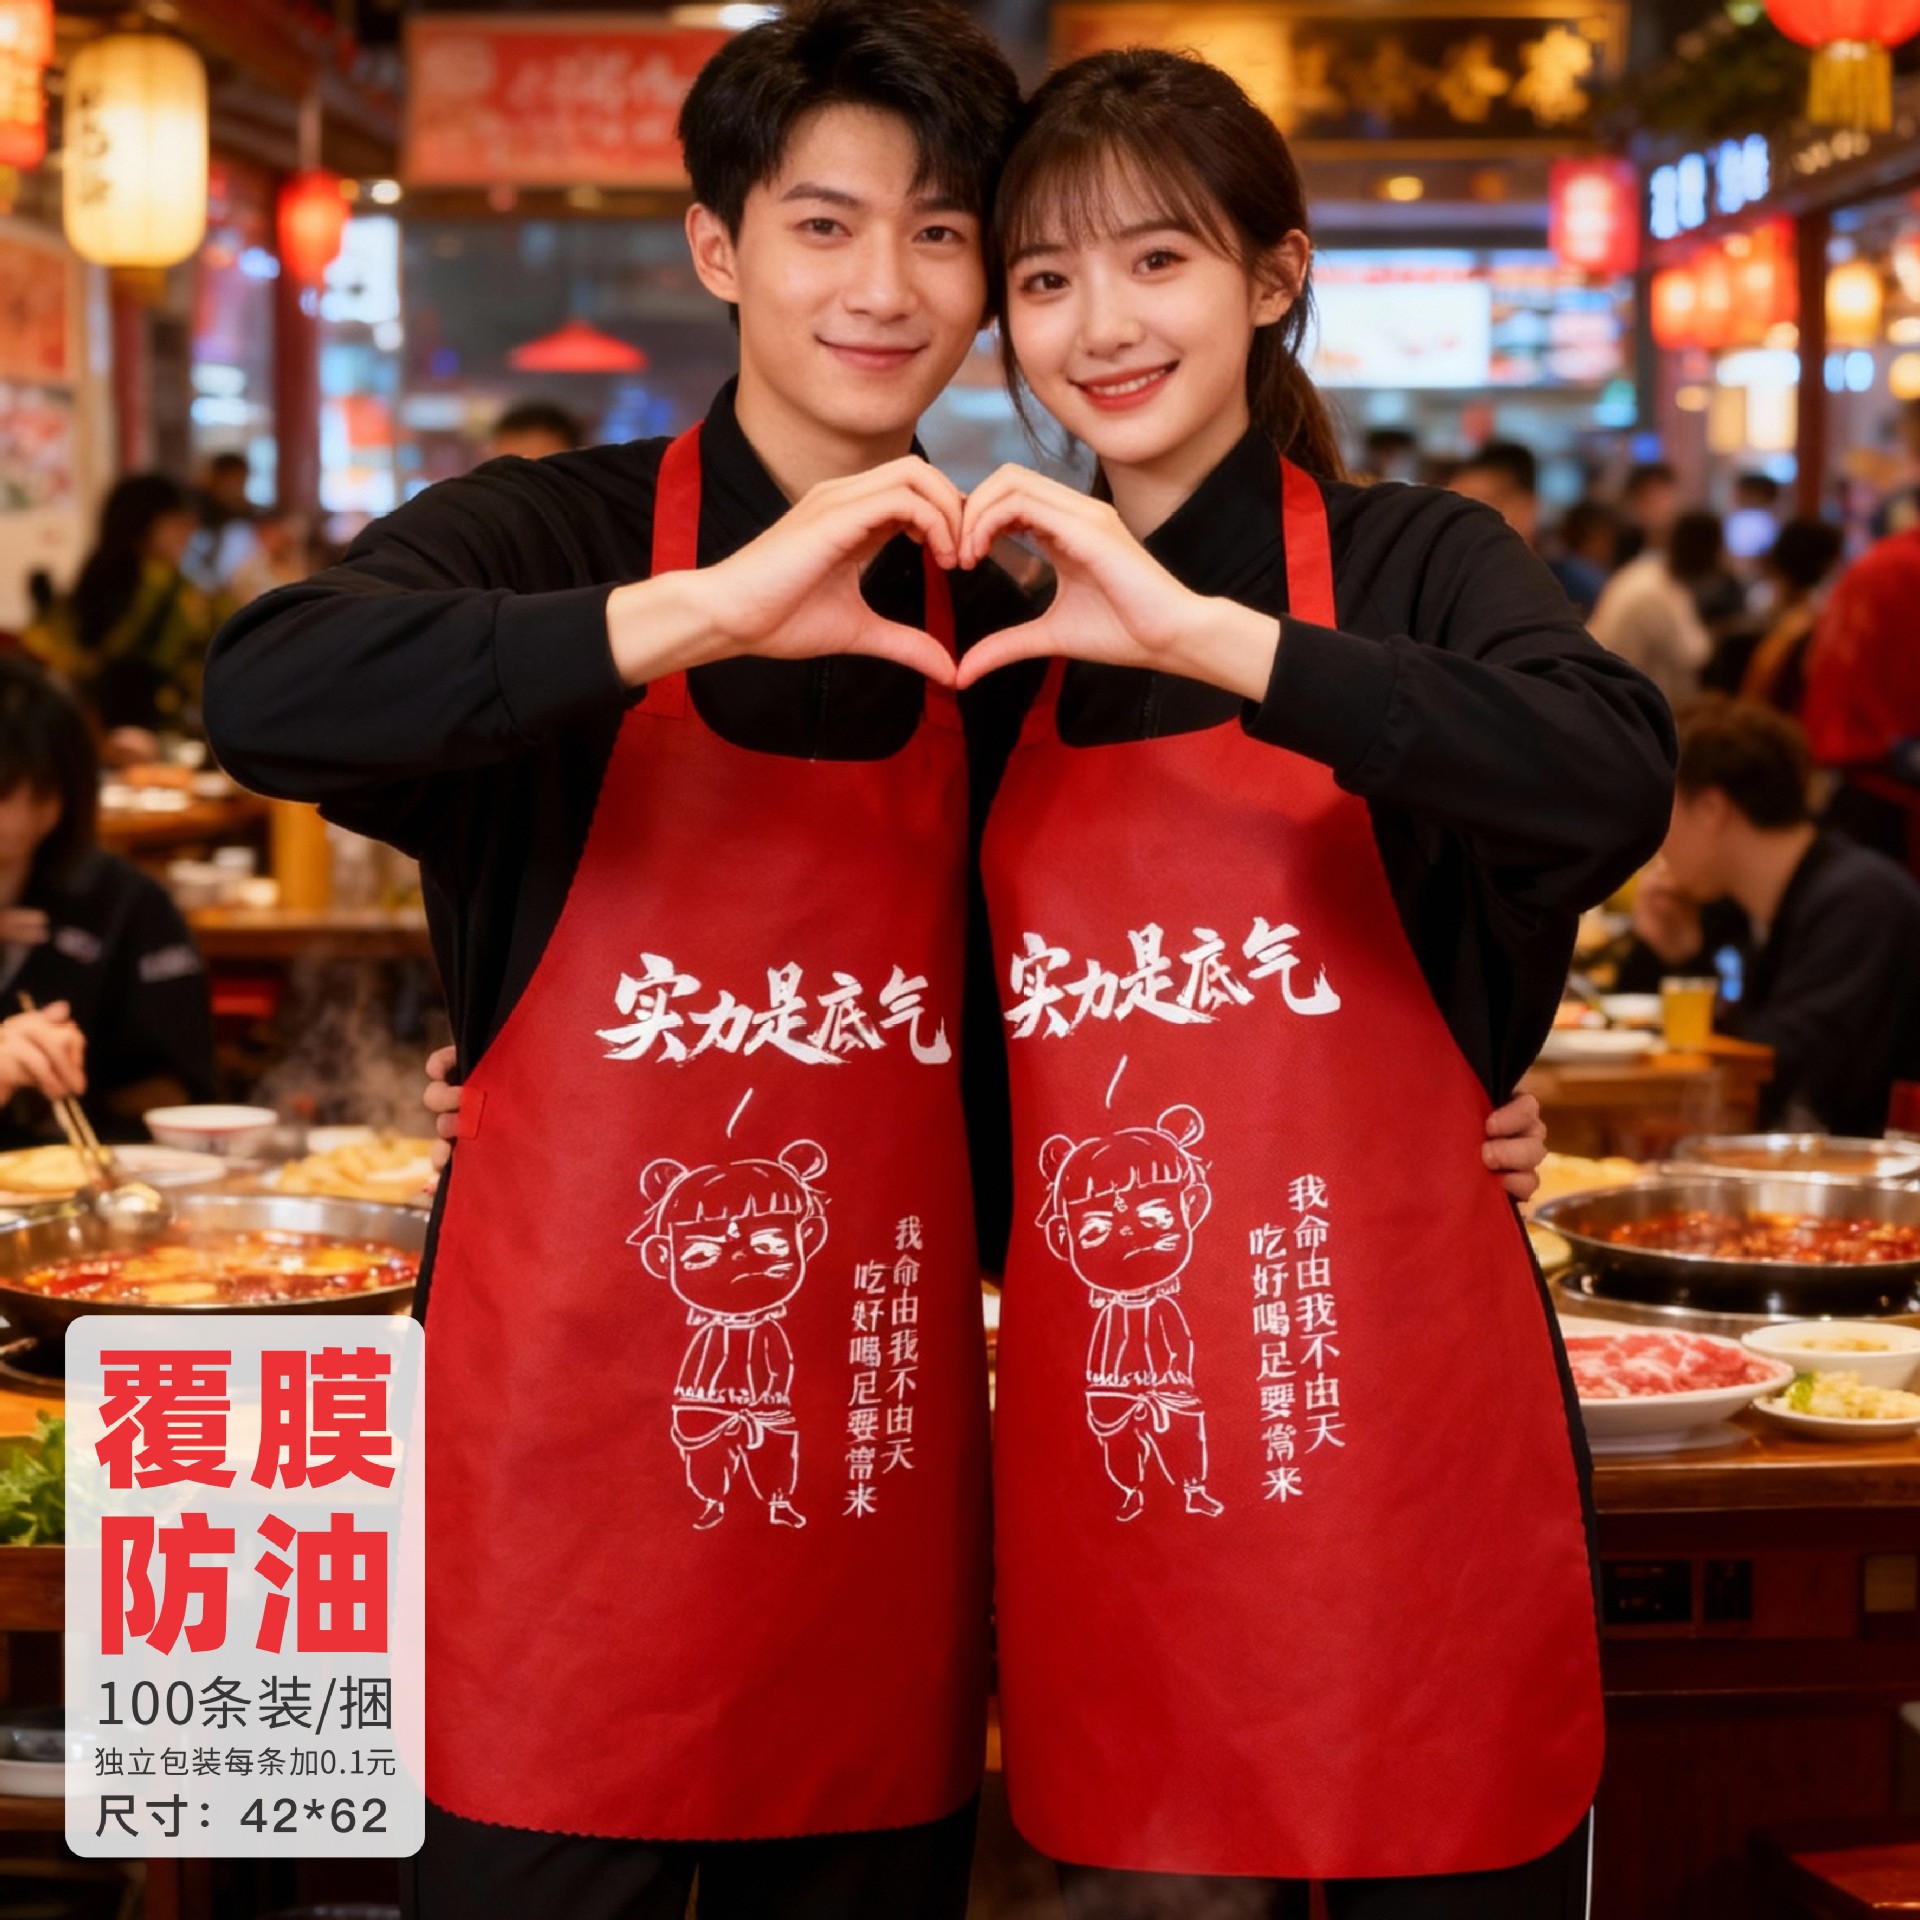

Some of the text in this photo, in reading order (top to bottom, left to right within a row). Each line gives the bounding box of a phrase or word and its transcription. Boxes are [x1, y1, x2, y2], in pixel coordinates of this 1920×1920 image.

[595, 952, 952, 1067] 实力是底气
[1004, 917, 1341, 1040] 实力是底气
[880, 1215, 923, 1475] 我命由我不由天
[1288, 1173, 1346, 1455] 我命由我不由天
